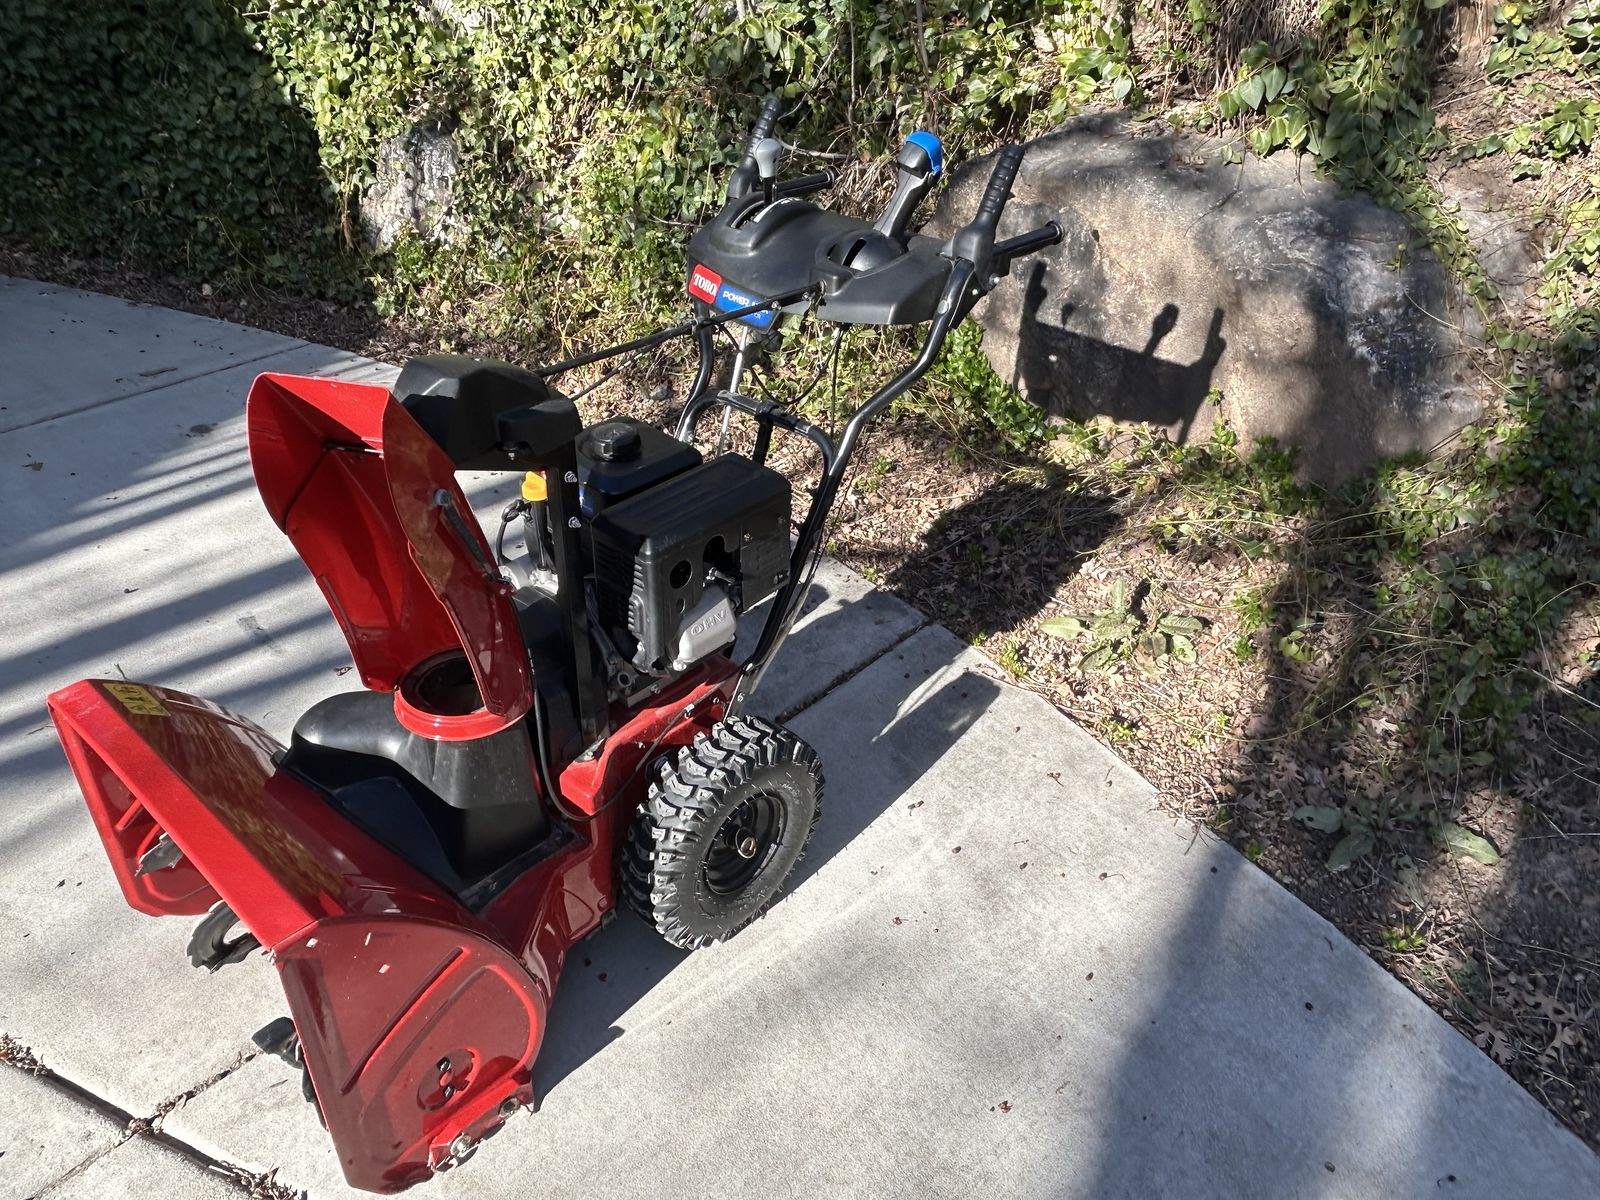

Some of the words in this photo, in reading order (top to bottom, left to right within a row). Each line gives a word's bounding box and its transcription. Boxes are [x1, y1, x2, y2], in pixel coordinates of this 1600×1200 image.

[693, 273, 717, 297] TORO
[723, 291, 750, 307] POWER
[691, 609, 727, 636] OHV
